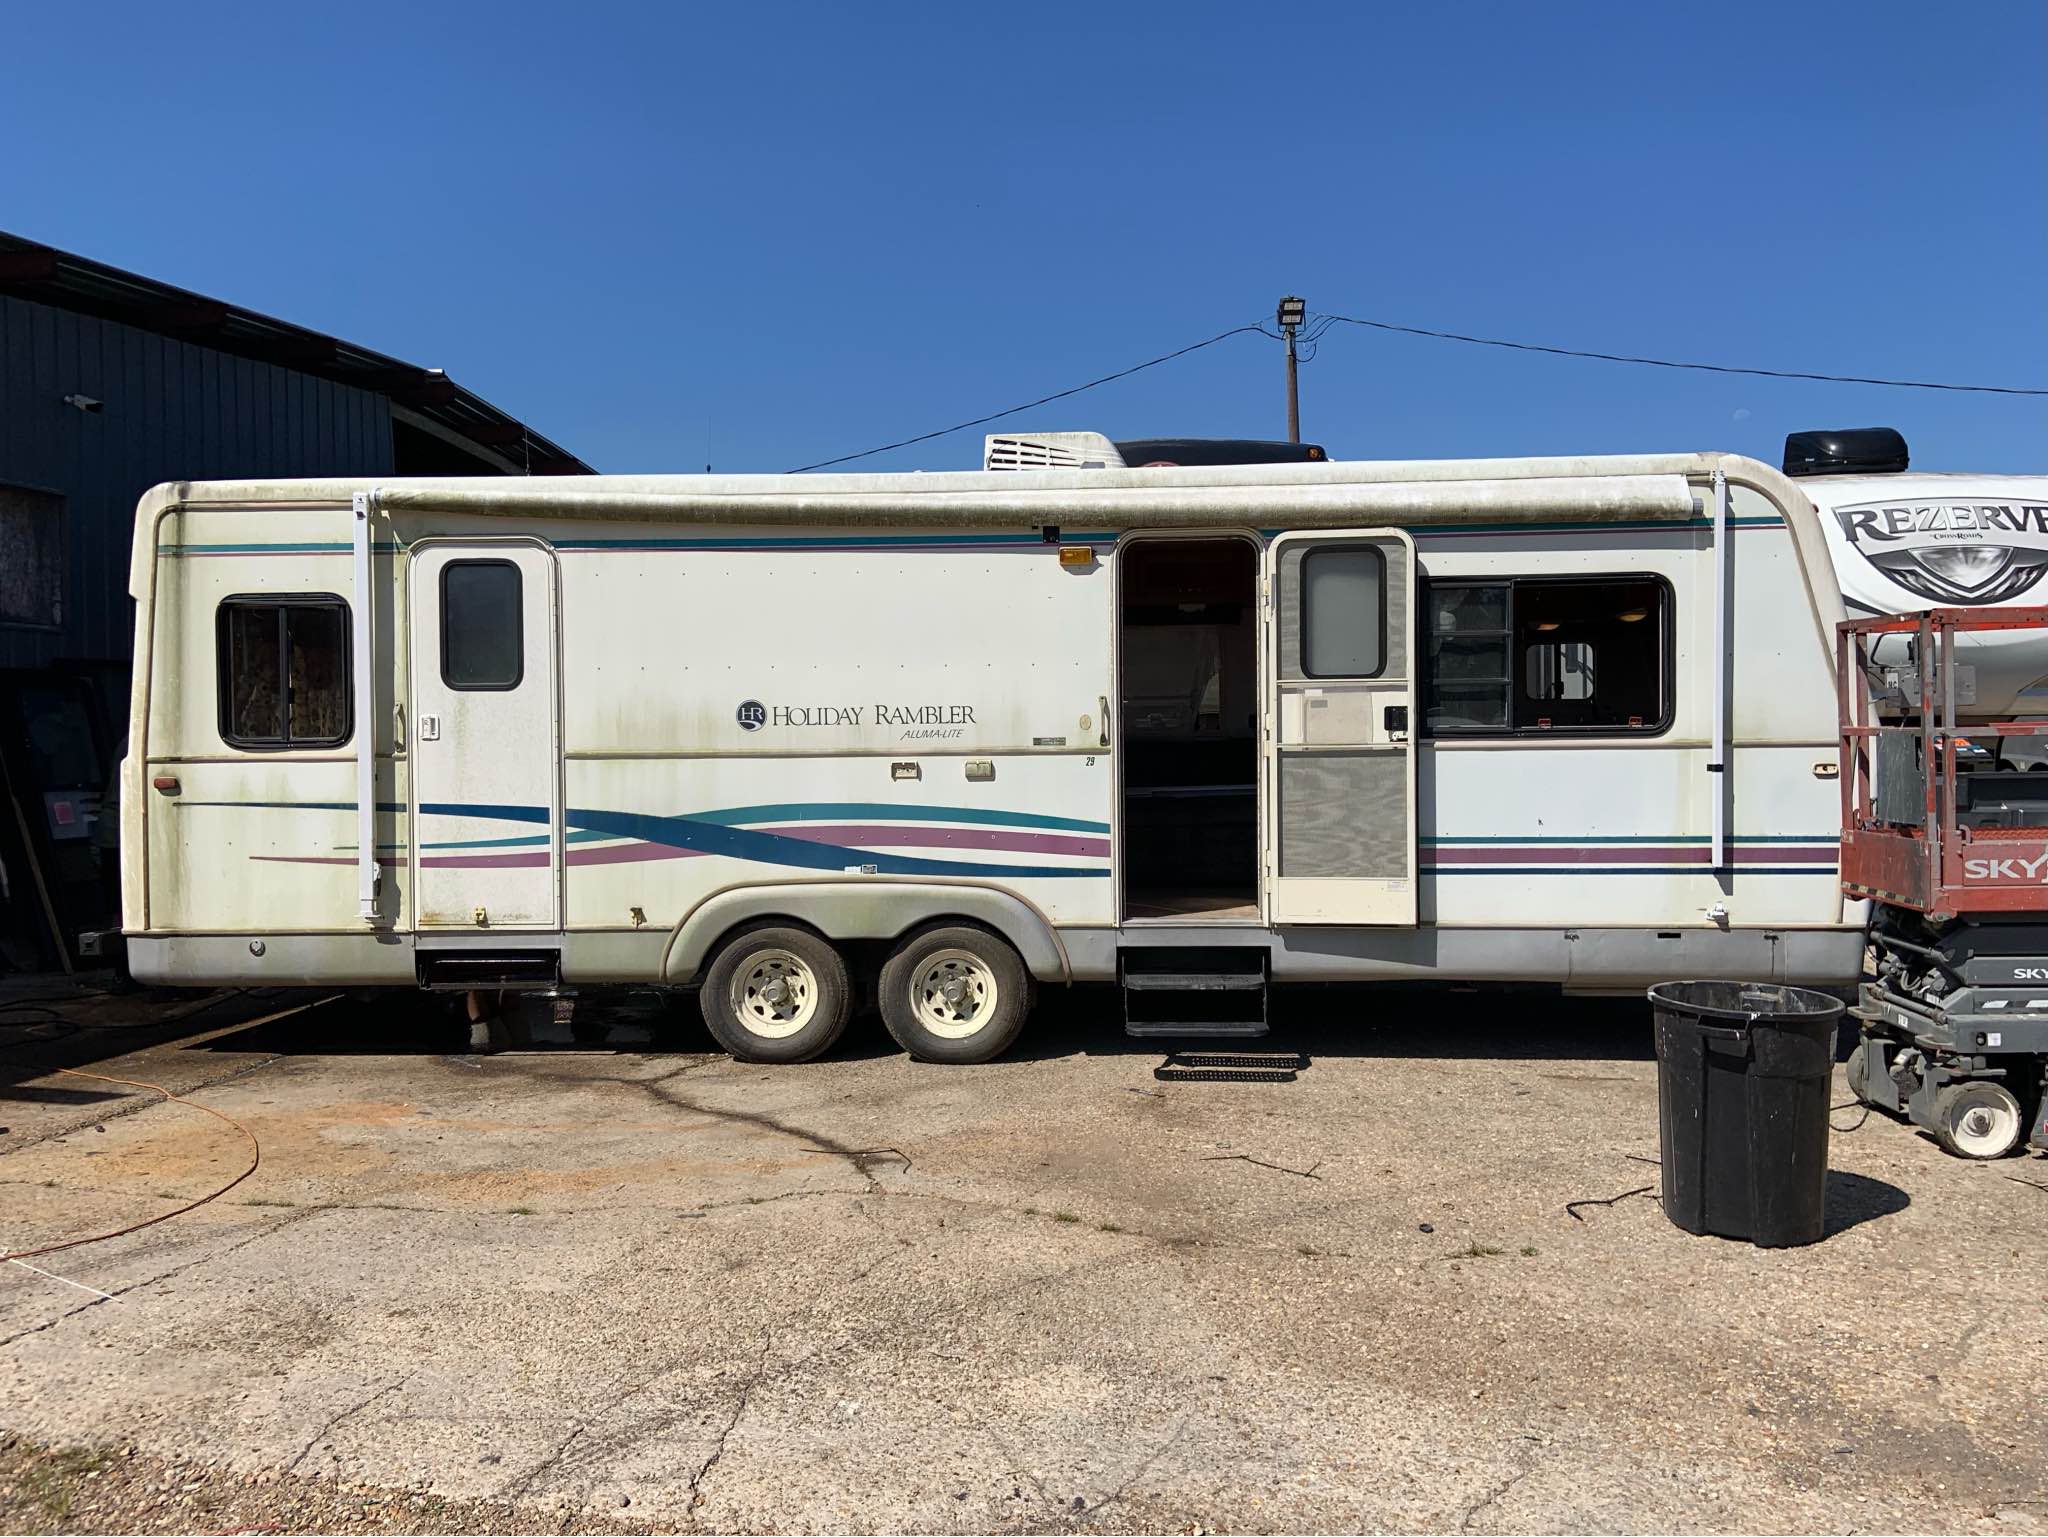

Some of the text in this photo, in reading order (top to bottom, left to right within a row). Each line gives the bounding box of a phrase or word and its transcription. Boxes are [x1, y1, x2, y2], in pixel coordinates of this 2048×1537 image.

[741, 707, 763, 720] HR
[772, 704, 977, 726] HOLIDAY RAMBLER
[899, 729, 965, 741] ALUMA-LITE
[1085, 756, 1096, 767] 29
